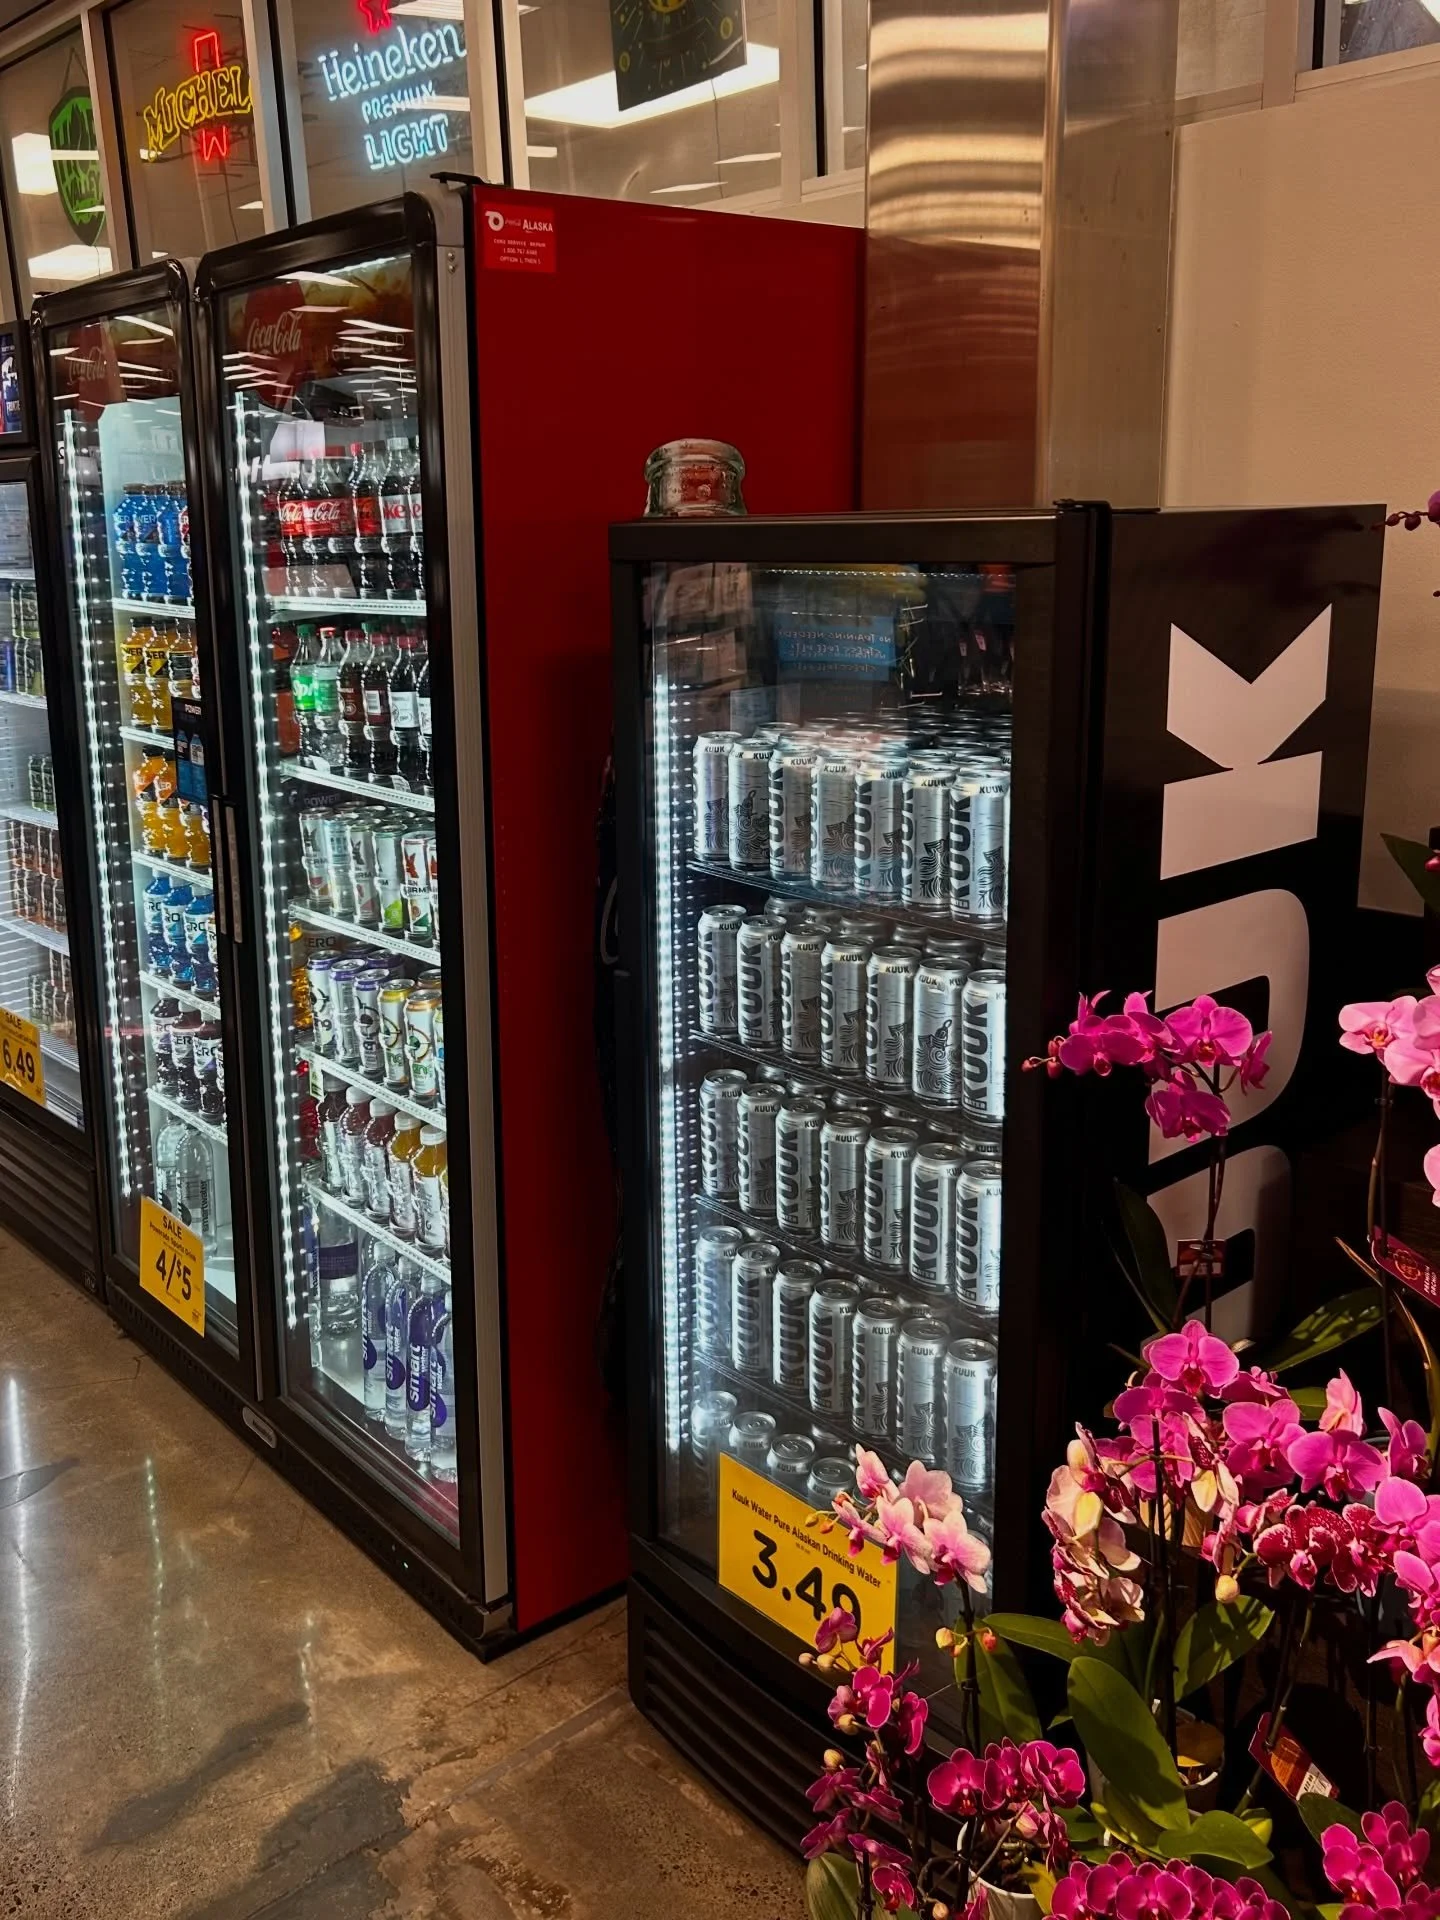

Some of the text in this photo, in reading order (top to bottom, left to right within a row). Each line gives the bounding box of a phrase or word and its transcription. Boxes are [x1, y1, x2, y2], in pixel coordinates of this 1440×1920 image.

[317, 24, 468, 101] Heineken
[143, 65, 254, 162] MICHEL
[361, 80, 437, 124] PREMIUM
[364, 113, 448, 170] LIGHT
[522, 219, 554, 232] ALASKA
[790, 757, 813, 767] KUUK
[824, 763, 848, 773] KUUK
[880, 770, 904, 780] KUUK
[921, 777, 947, 788] KUUK
[978, 784, 1004, 794] KUUK
[855, 781, 873, 878] KUUK
[950, 795, 971, 895] KUUK
[797, 943, 820, 951] KUUK
[839, 953, 864, 962] KUUK
[885, 965, 910, 974] KUUK
[740, 942, 763, 1032] KUUK
[1141, 603, 1333, 1356] UUK
[963, 1000, 988, 1101] KUUK
[835, 1134, 858, 1143] KUUK
[778, 1129, 799, 1217] KUUK
[162, 1214, 183, 1241] SALE
[864, 1159, 884, 1254] KUUK
[912, 1173, 939, 1275] KUUK
[957, 1191, 978, 1290] KUUK
[779, 1293, 806, 1382] KUUK
[871, 1326, 896, 1336] KUUK
[911, 1345, 935, 1356] KUUK
[408, 1344, 421, 1402] smart
[953, 1367, 977, 1378] KUUK
[731, 1487, 750, 1508] Kuuk
[750, 1499, 773, 1521] Water
[773, 1514, 791, 1533] Pure
[791, 1526, 821, 1552] Alaskan
[822, 1544, 855, 1575] Drinking
[856, 1565, 882, 1588] Water
